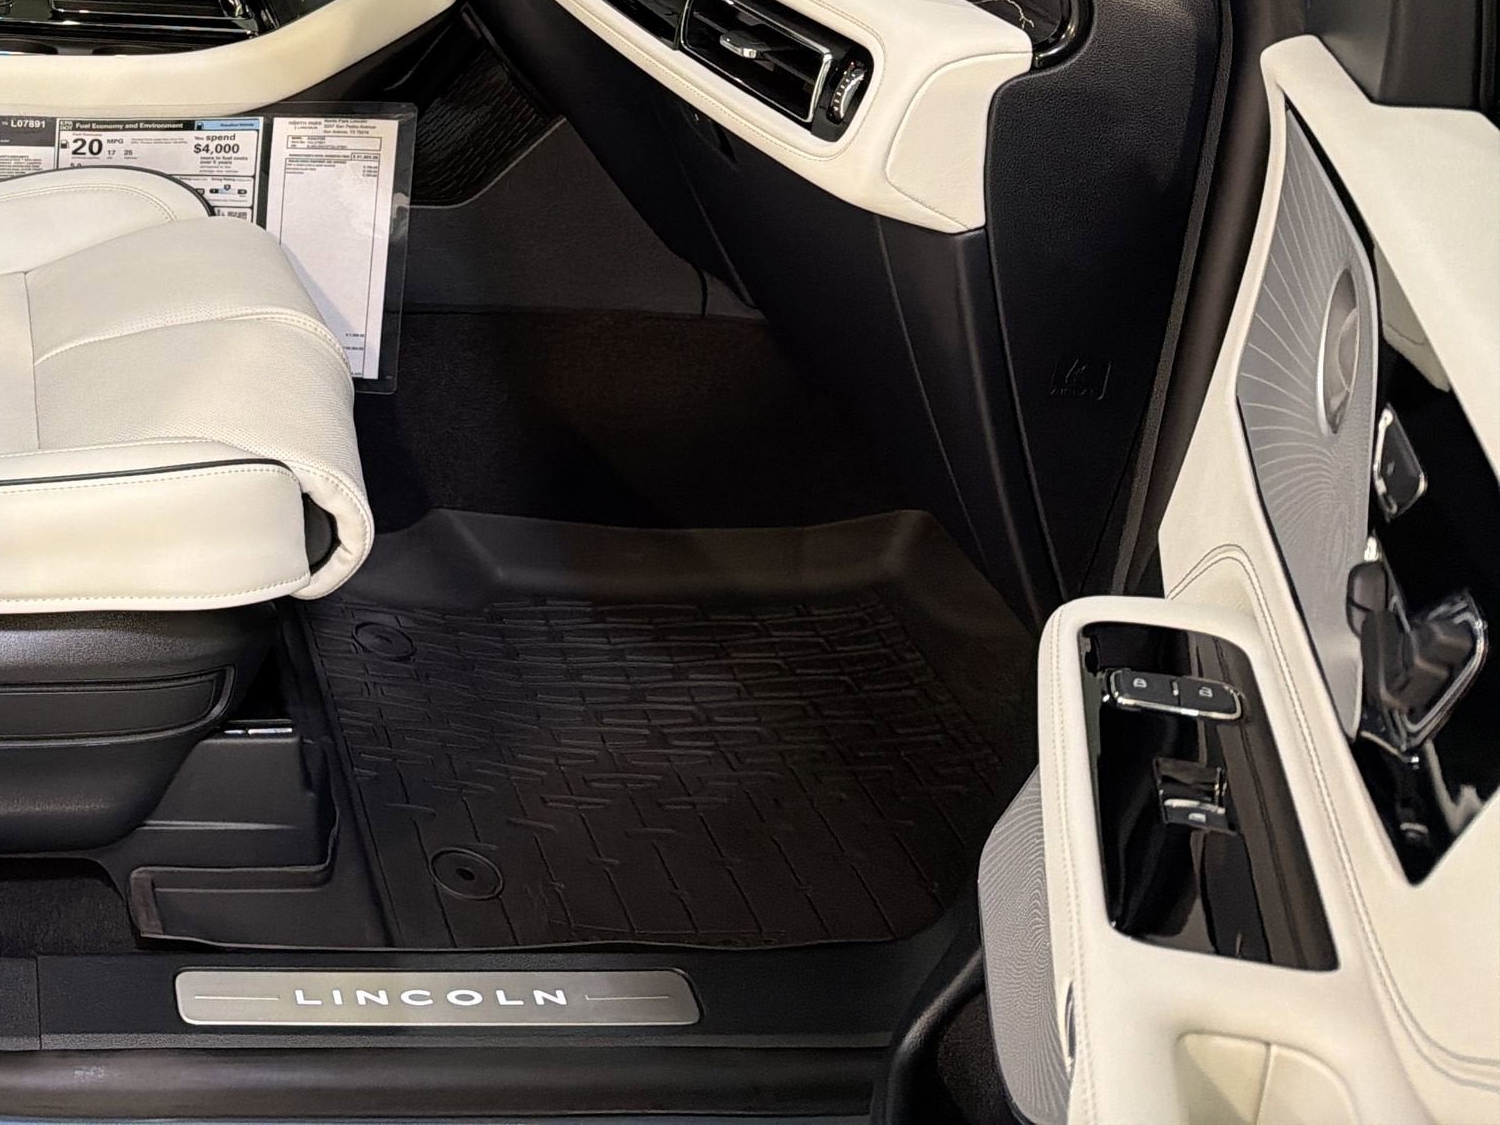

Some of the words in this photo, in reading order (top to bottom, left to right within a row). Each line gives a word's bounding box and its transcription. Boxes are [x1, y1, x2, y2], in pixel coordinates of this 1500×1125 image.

[10, 119, 46, 128] L07891
[92, 122, 123, 131] Economy
[205, 133, 236, 142] spend
[71, 138, 103, 156] 20
[193, 143, 240, 155] $4,000
[295, 988, 568, 1006] LINCOLN
